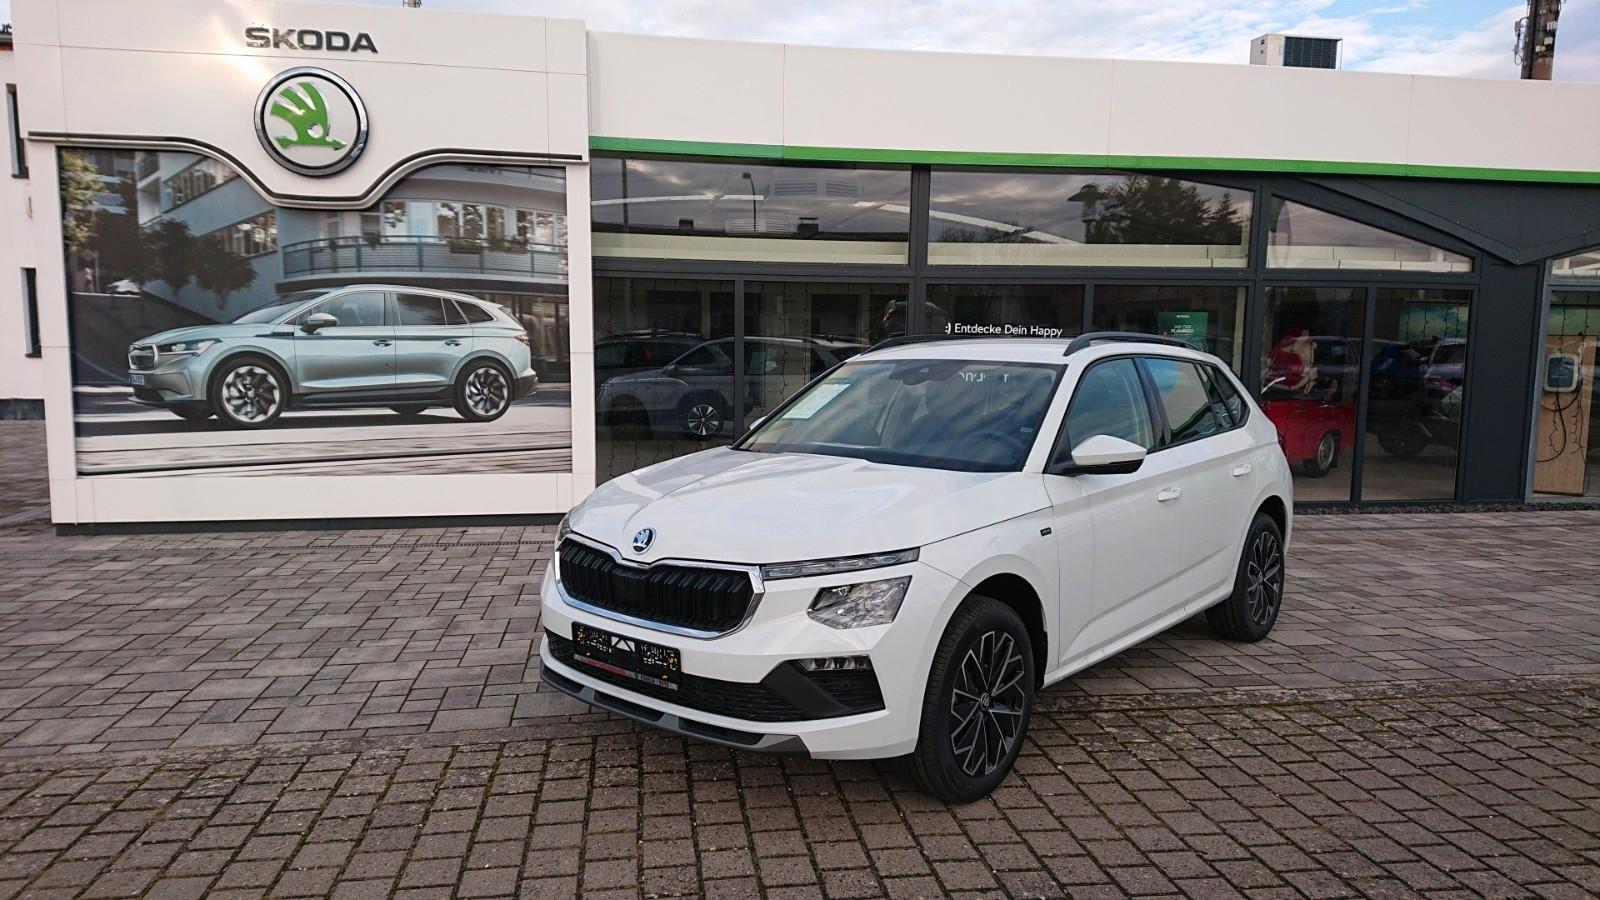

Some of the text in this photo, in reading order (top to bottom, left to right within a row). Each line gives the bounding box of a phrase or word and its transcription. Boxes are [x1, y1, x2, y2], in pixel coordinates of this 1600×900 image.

[954, 323, 1002, 334] Entdecke
[1004, 325, 1027, 335] Dein
[1030, 326, 1063, 338] Happy
